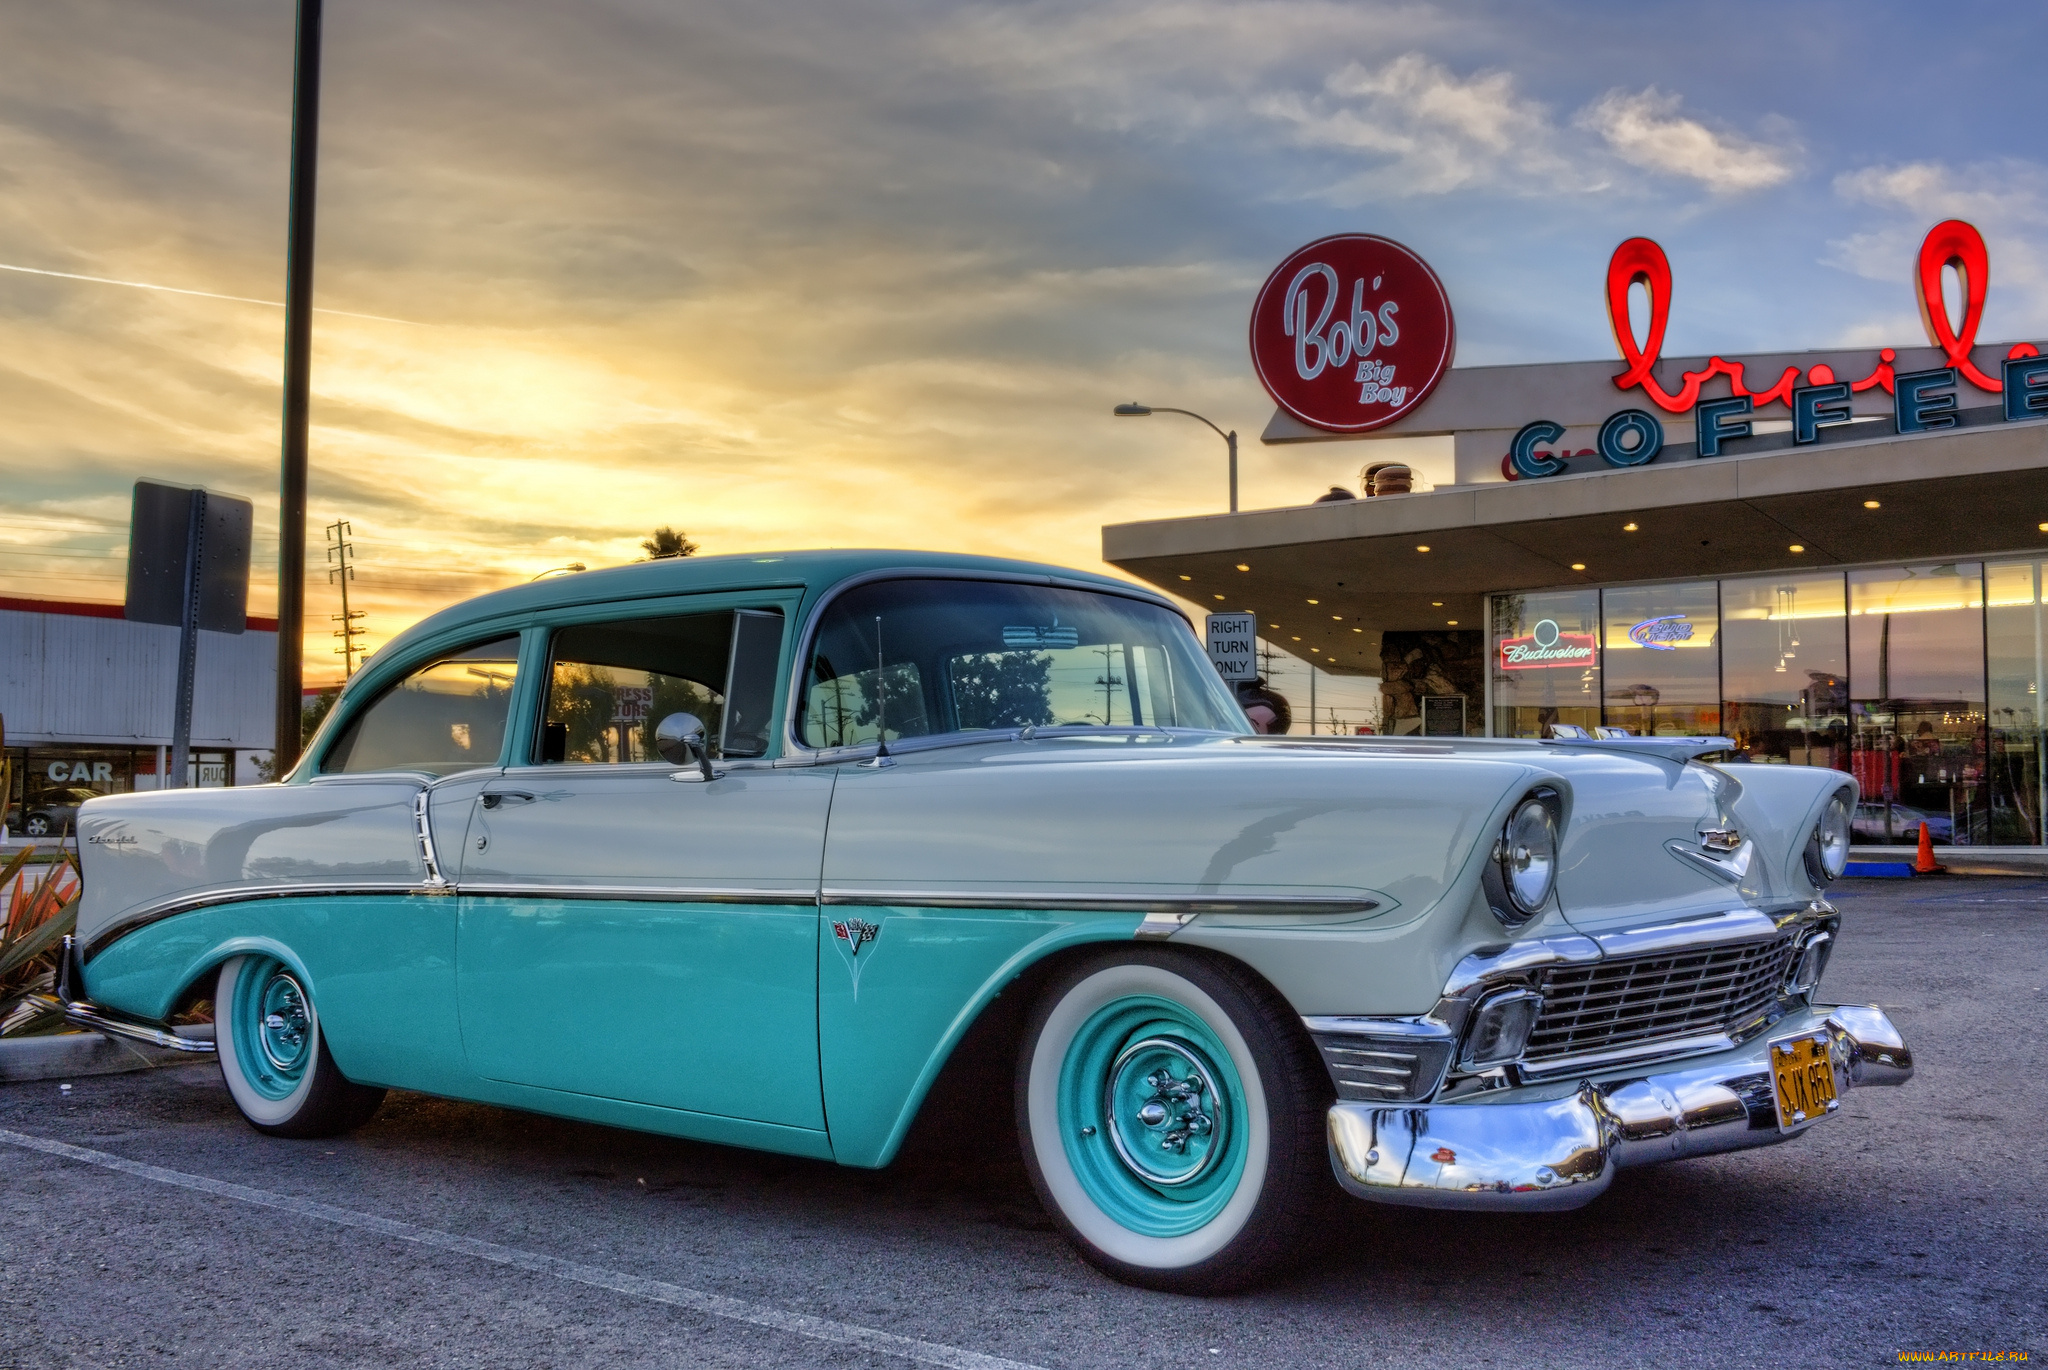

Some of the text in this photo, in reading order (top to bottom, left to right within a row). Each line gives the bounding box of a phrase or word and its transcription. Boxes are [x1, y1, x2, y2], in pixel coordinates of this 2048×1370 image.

[1284, 262, 1399, 380] Bob's
[1355, 359, 1396, 386] Big
[1359, 382, 1407, 407] Boy
[1510, 353, 2048, 479] COFFEE
[1211, 620, 1249, 634] RIGHT
[1214, 641, 1249, 654] TURN
[1503, 644, 1593, 664] Budweiser
[1215, 660, 1249, 675] ONLY
[47, 761, 114, 783] CAR
[1777, 1064, 1811, 1117] SJX
